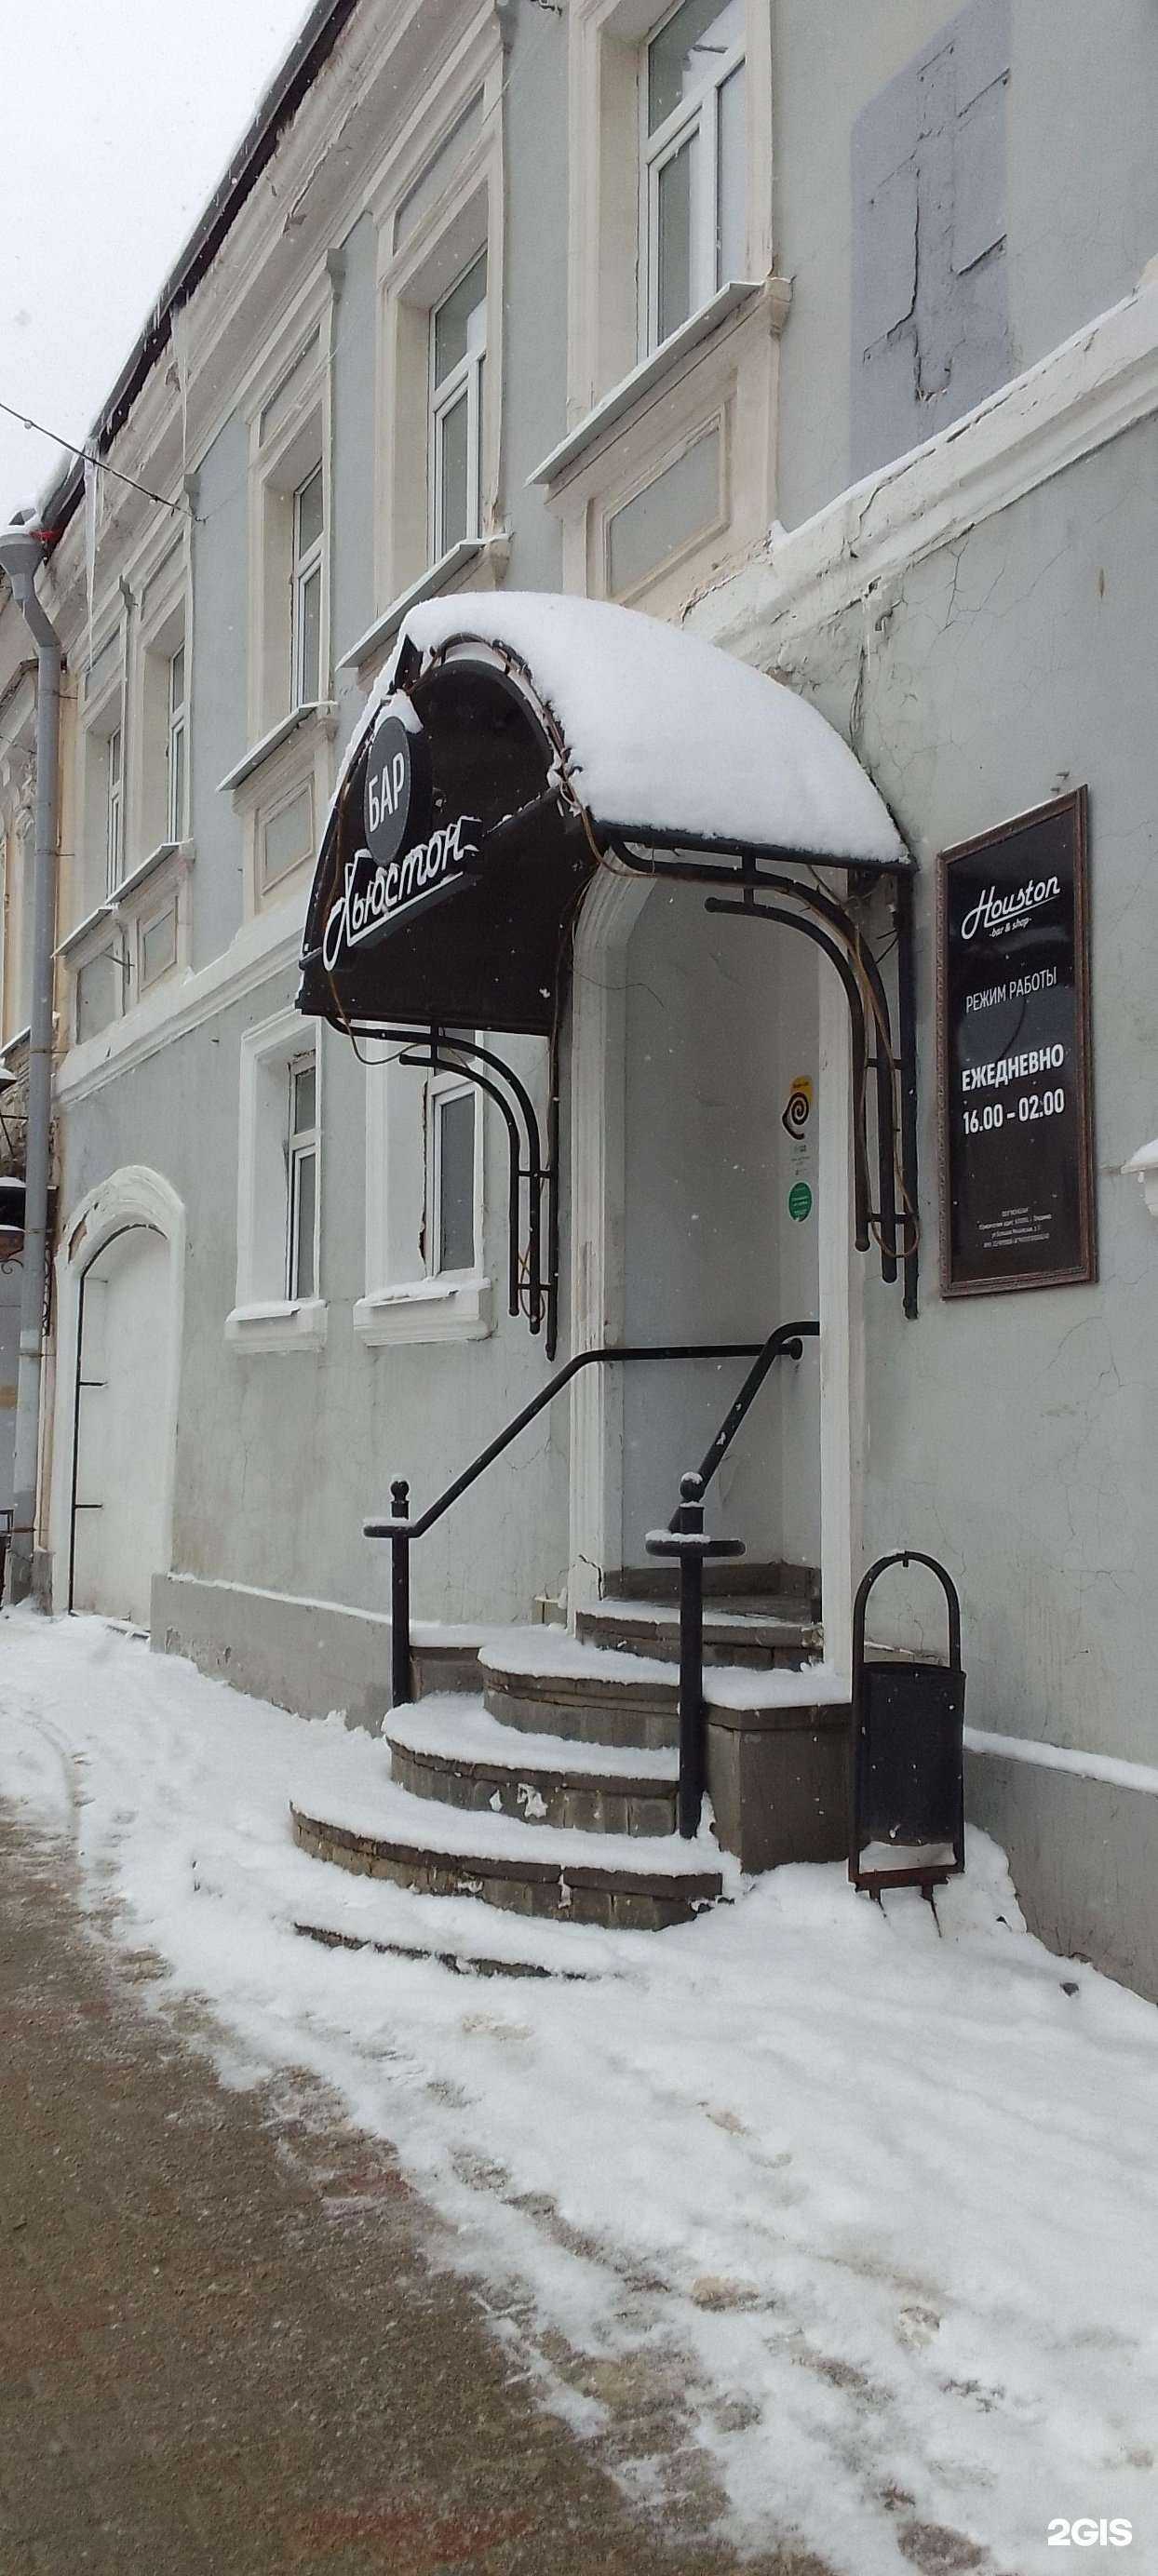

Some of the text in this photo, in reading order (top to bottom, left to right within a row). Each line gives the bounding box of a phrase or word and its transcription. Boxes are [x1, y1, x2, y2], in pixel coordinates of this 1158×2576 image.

[368, 752, 405, 833] БАР
[322, 815, 483, 972] Хьюстон
[962, 877, 1060, 939] Houston
[966, 967, 1057, 1013] РЕЖИМ РАБОТЫ
[963, 1044, 1064, 1092] ЕЖЕДНЕВНО
[963, 1104, 1003, 1134] 16.00
[1019, 1088, 1065, 1121] 02.00
